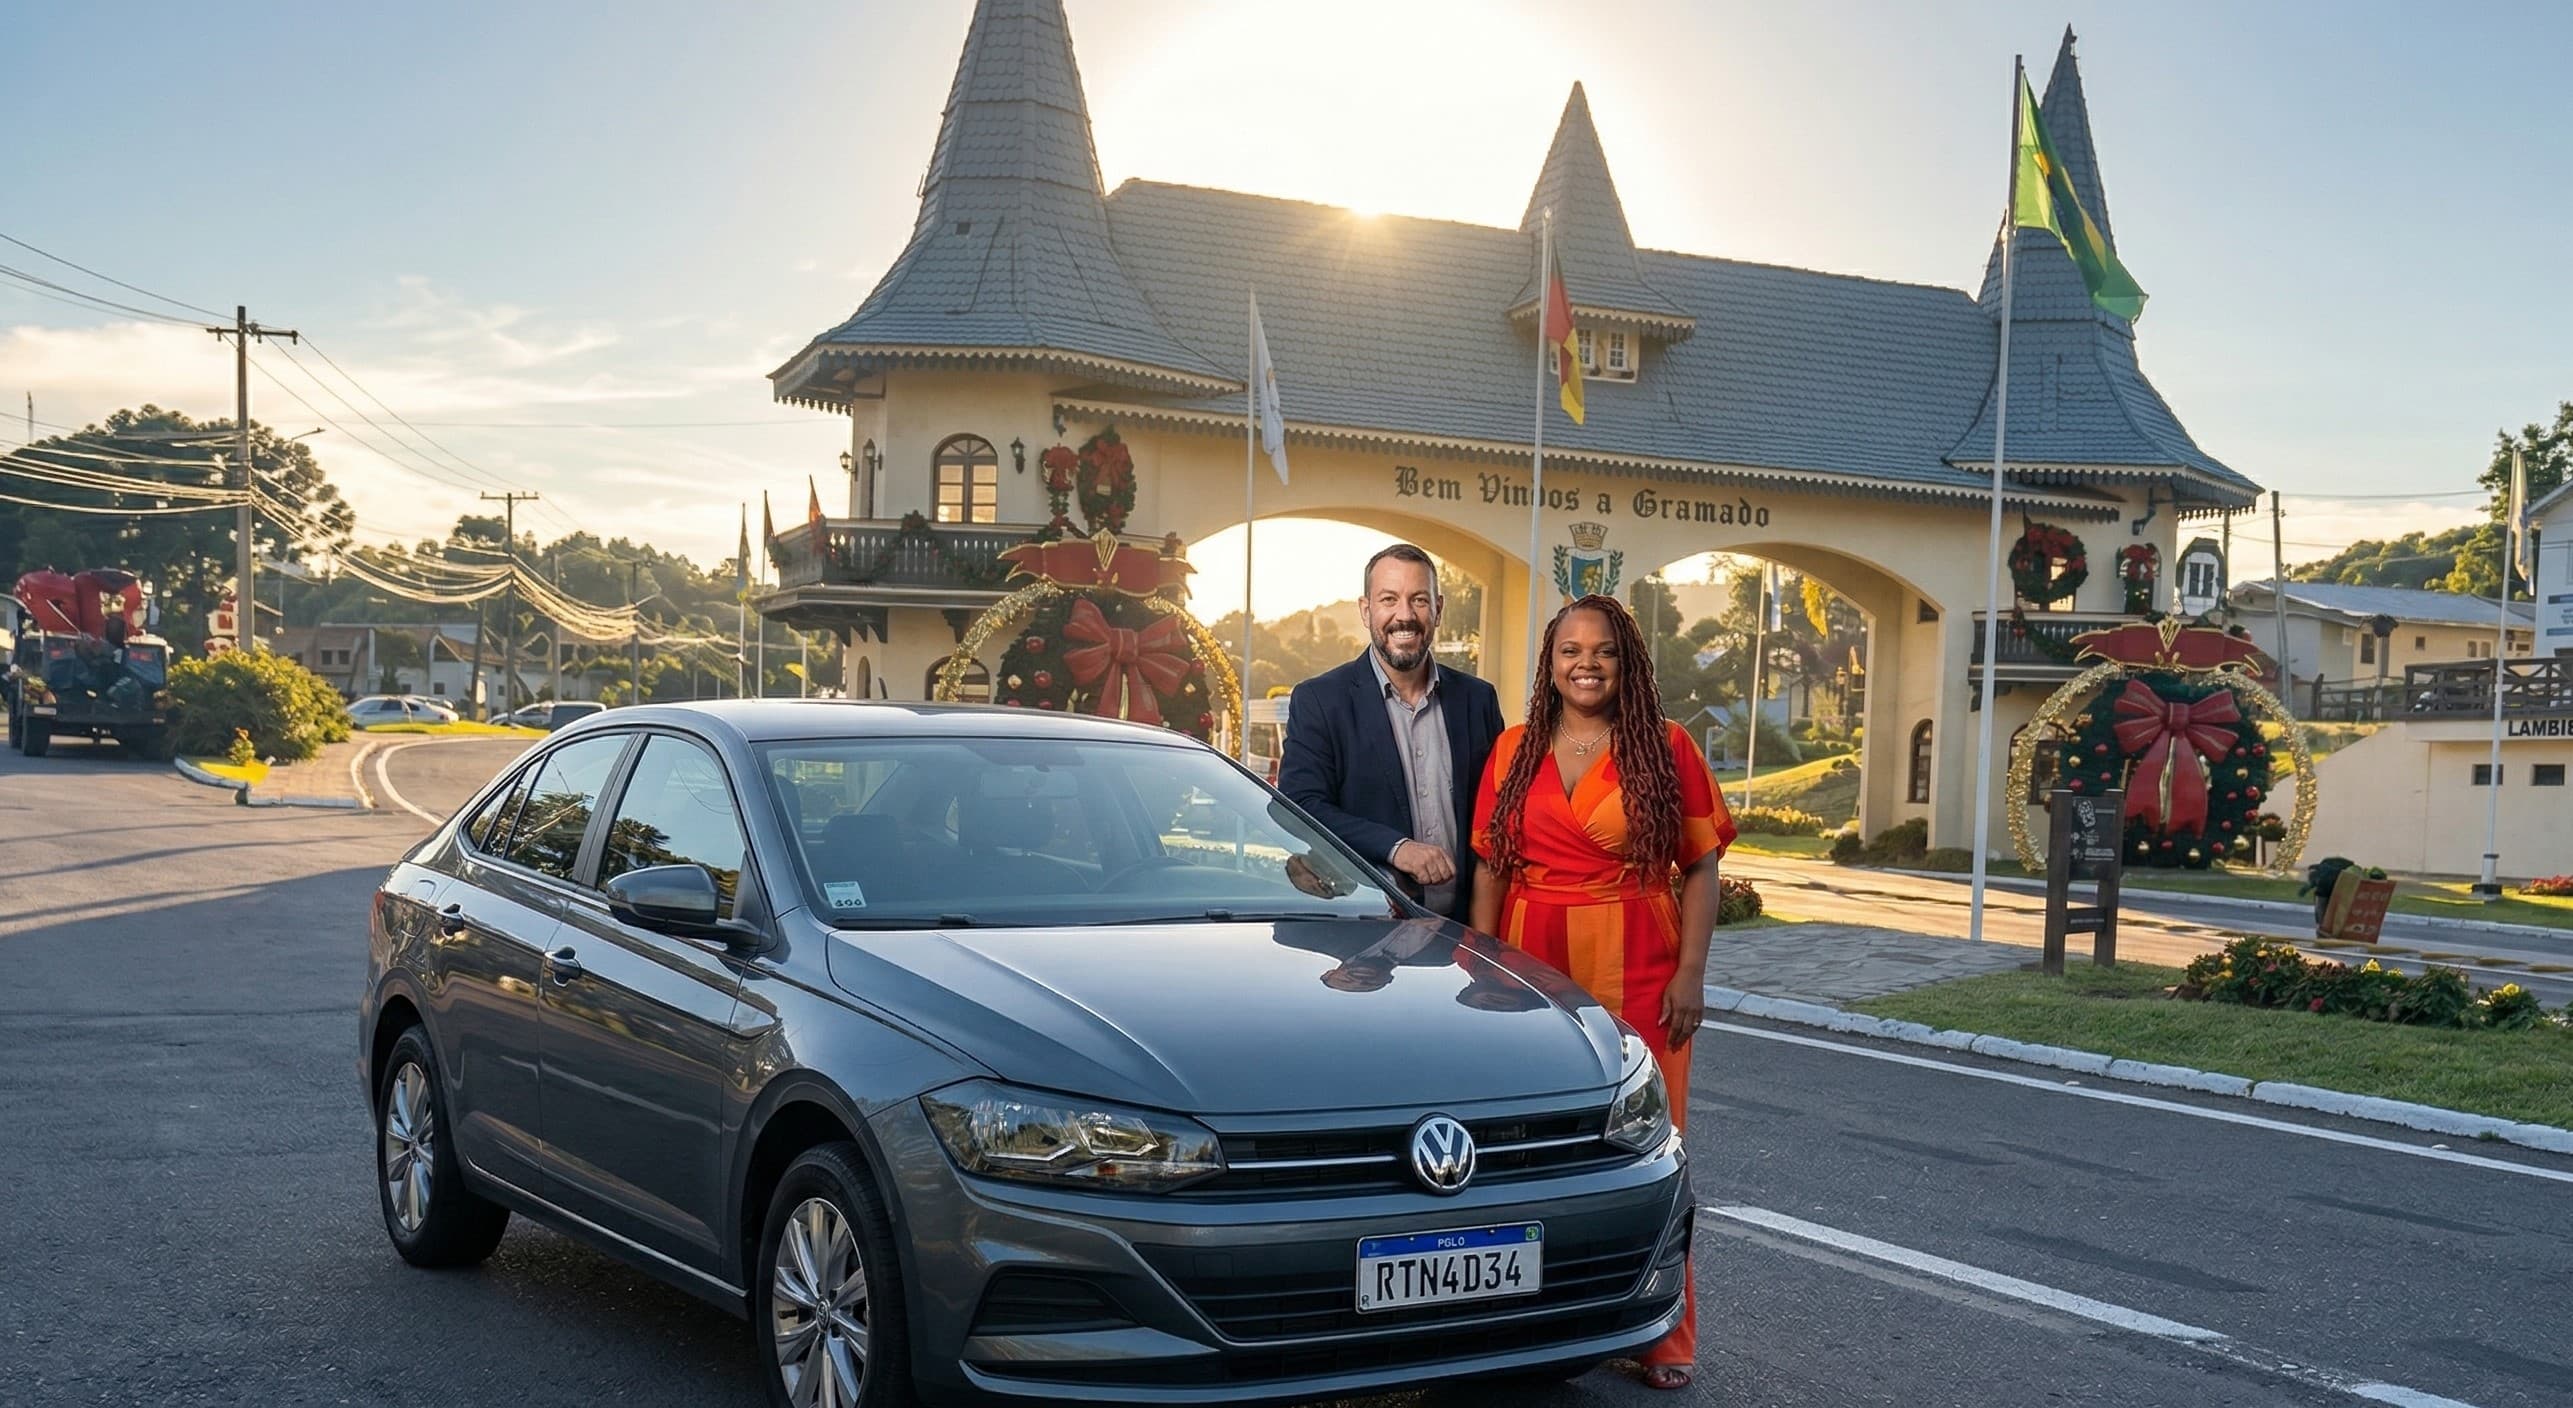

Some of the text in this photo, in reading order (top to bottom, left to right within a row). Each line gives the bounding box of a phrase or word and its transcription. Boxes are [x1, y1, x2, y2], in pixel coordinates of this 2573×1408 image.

[1395, 466, 1462, 500] Bem
[1597, 493, 1612, 515] a
[1633, 488, 1769, 528] Gramado
[1376, 1250, 1521, 1301] RTN4D34
